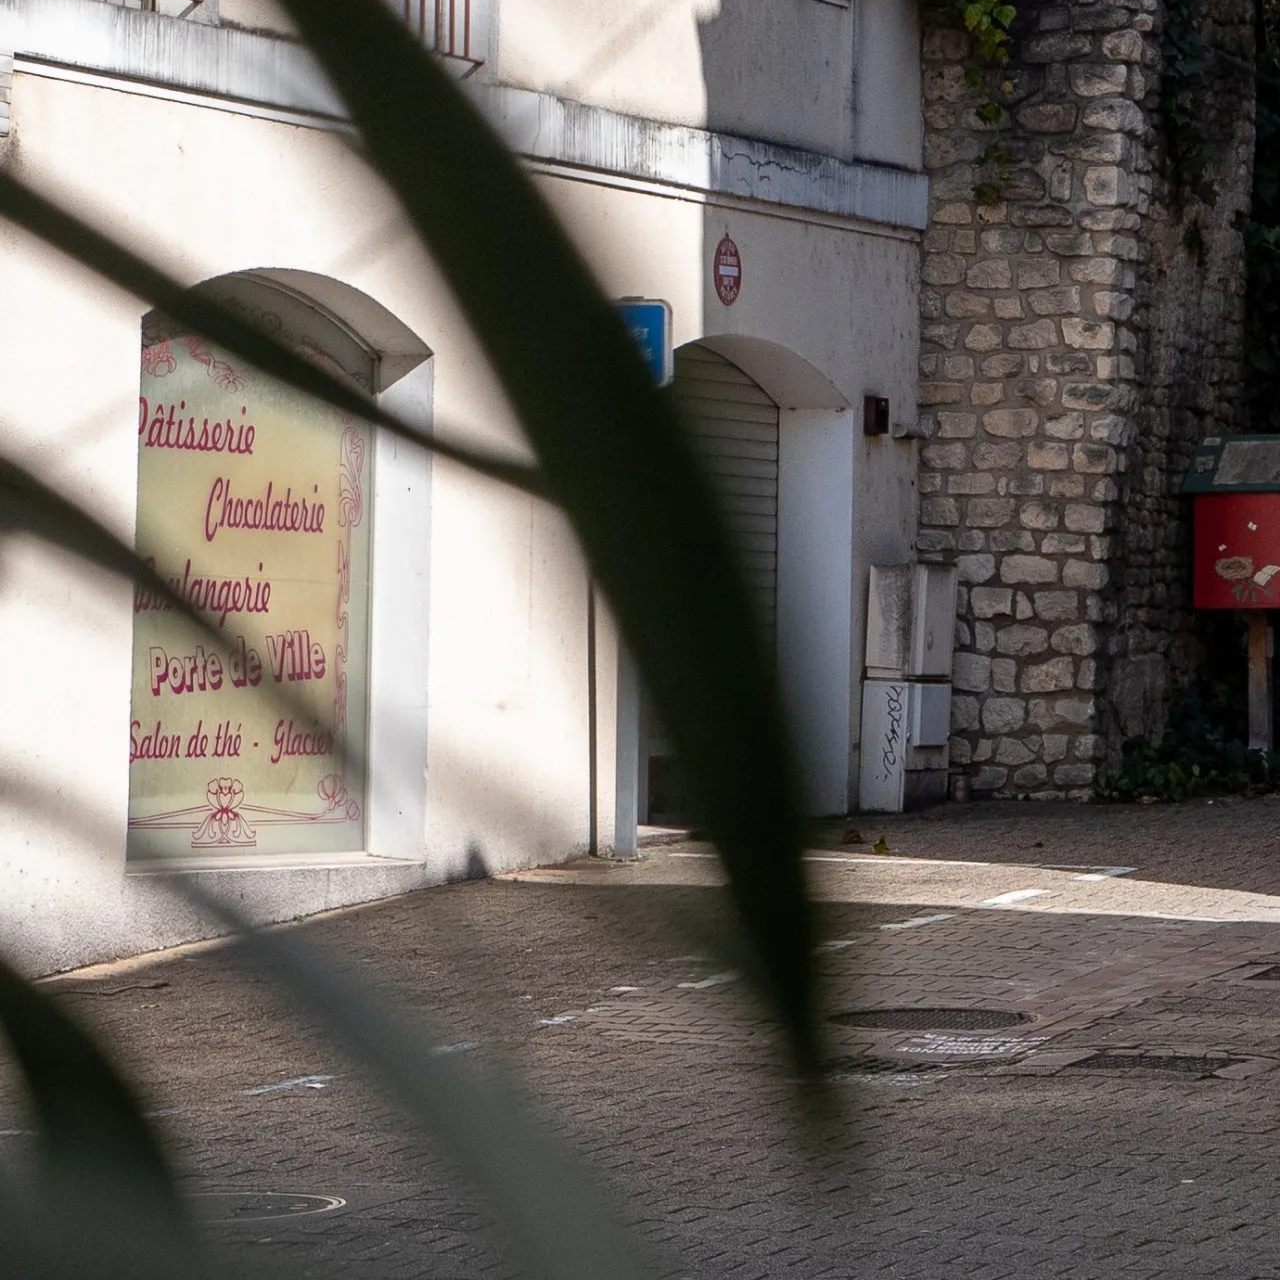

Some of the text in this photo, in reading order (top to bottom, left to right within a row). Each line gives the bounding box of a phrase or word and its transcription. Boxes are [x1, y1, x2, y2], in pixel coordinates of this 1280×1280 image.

[205, 476, 325, 542] Chocolaterie
[150, 629, 327, 696] Porte de Ville
[129, 720, 181, 764] Salon
[184, 719, 208, 759] de
[211, 720, 243, 758] thé
